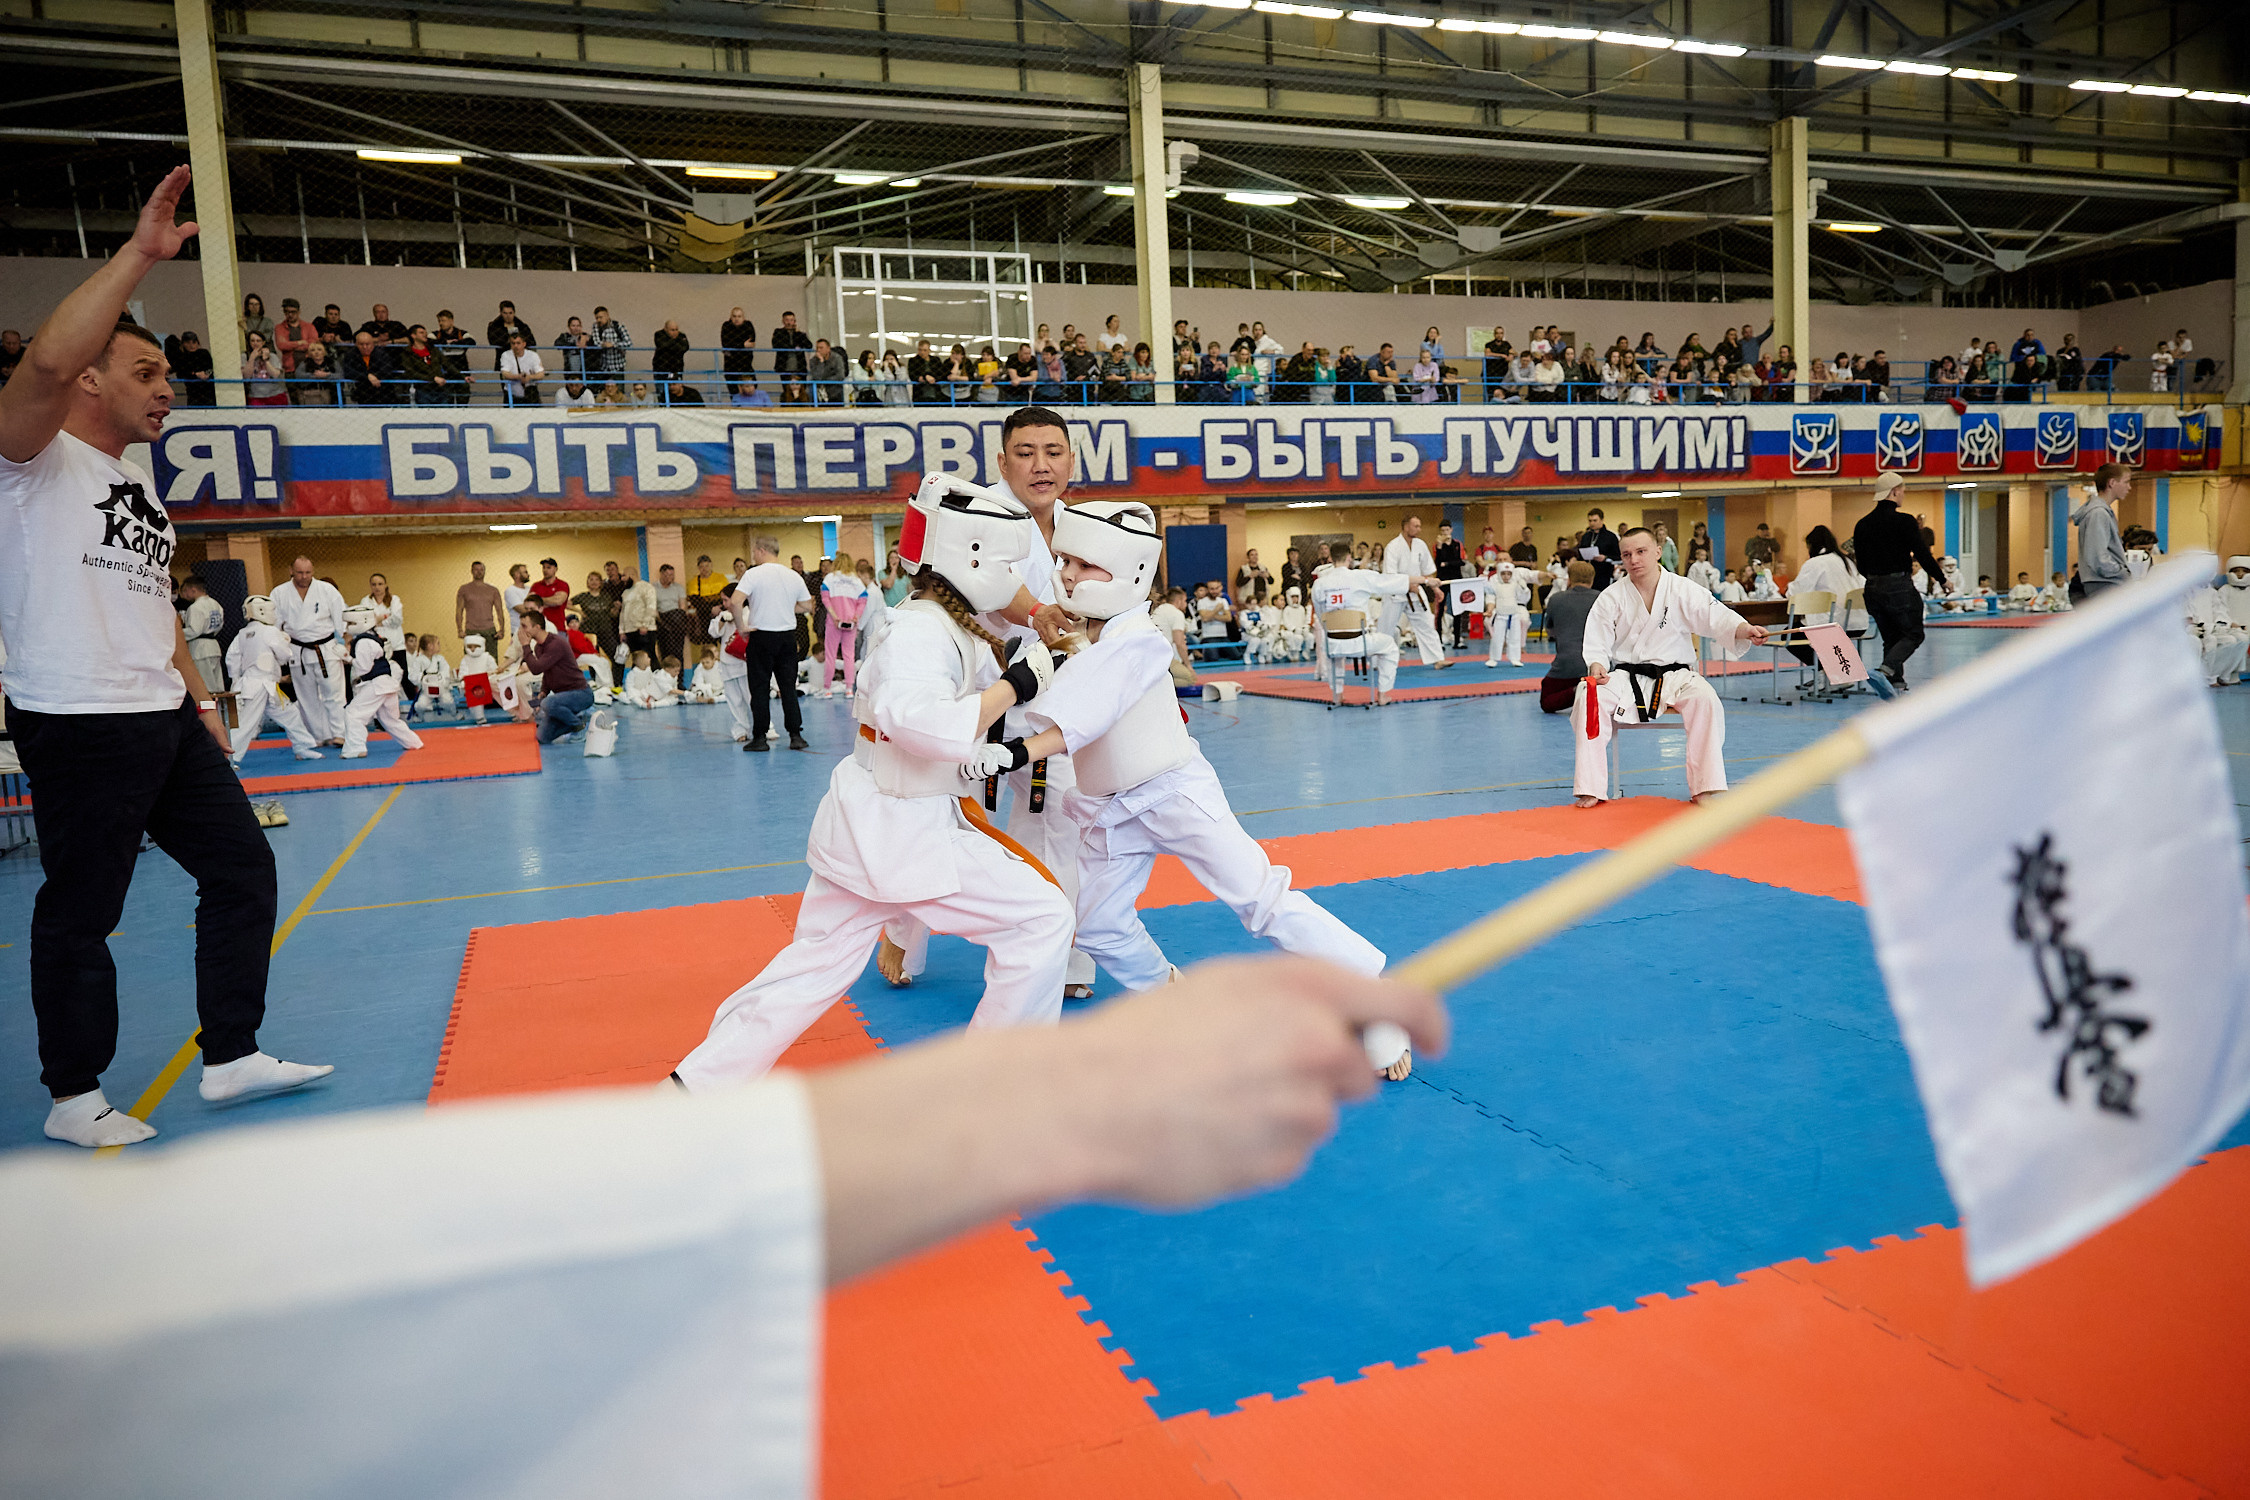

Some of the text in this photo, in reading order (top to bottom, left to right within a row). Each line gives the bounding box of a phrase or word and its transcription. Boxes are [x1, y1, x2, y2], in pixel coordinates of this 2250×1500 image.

[386, 426, 698, 496] БЫТЬ
[1203, 420, 1420, 480] БЫТЬ
[1440, 418, 1746, 475] ЛУЧШИМ!
[100, 511, 175, 571] Kapp
[82, 553, 134, 573] Authentic
[127, 579, 152, 595] Since
[1330, 594, 1343, 605] 31
